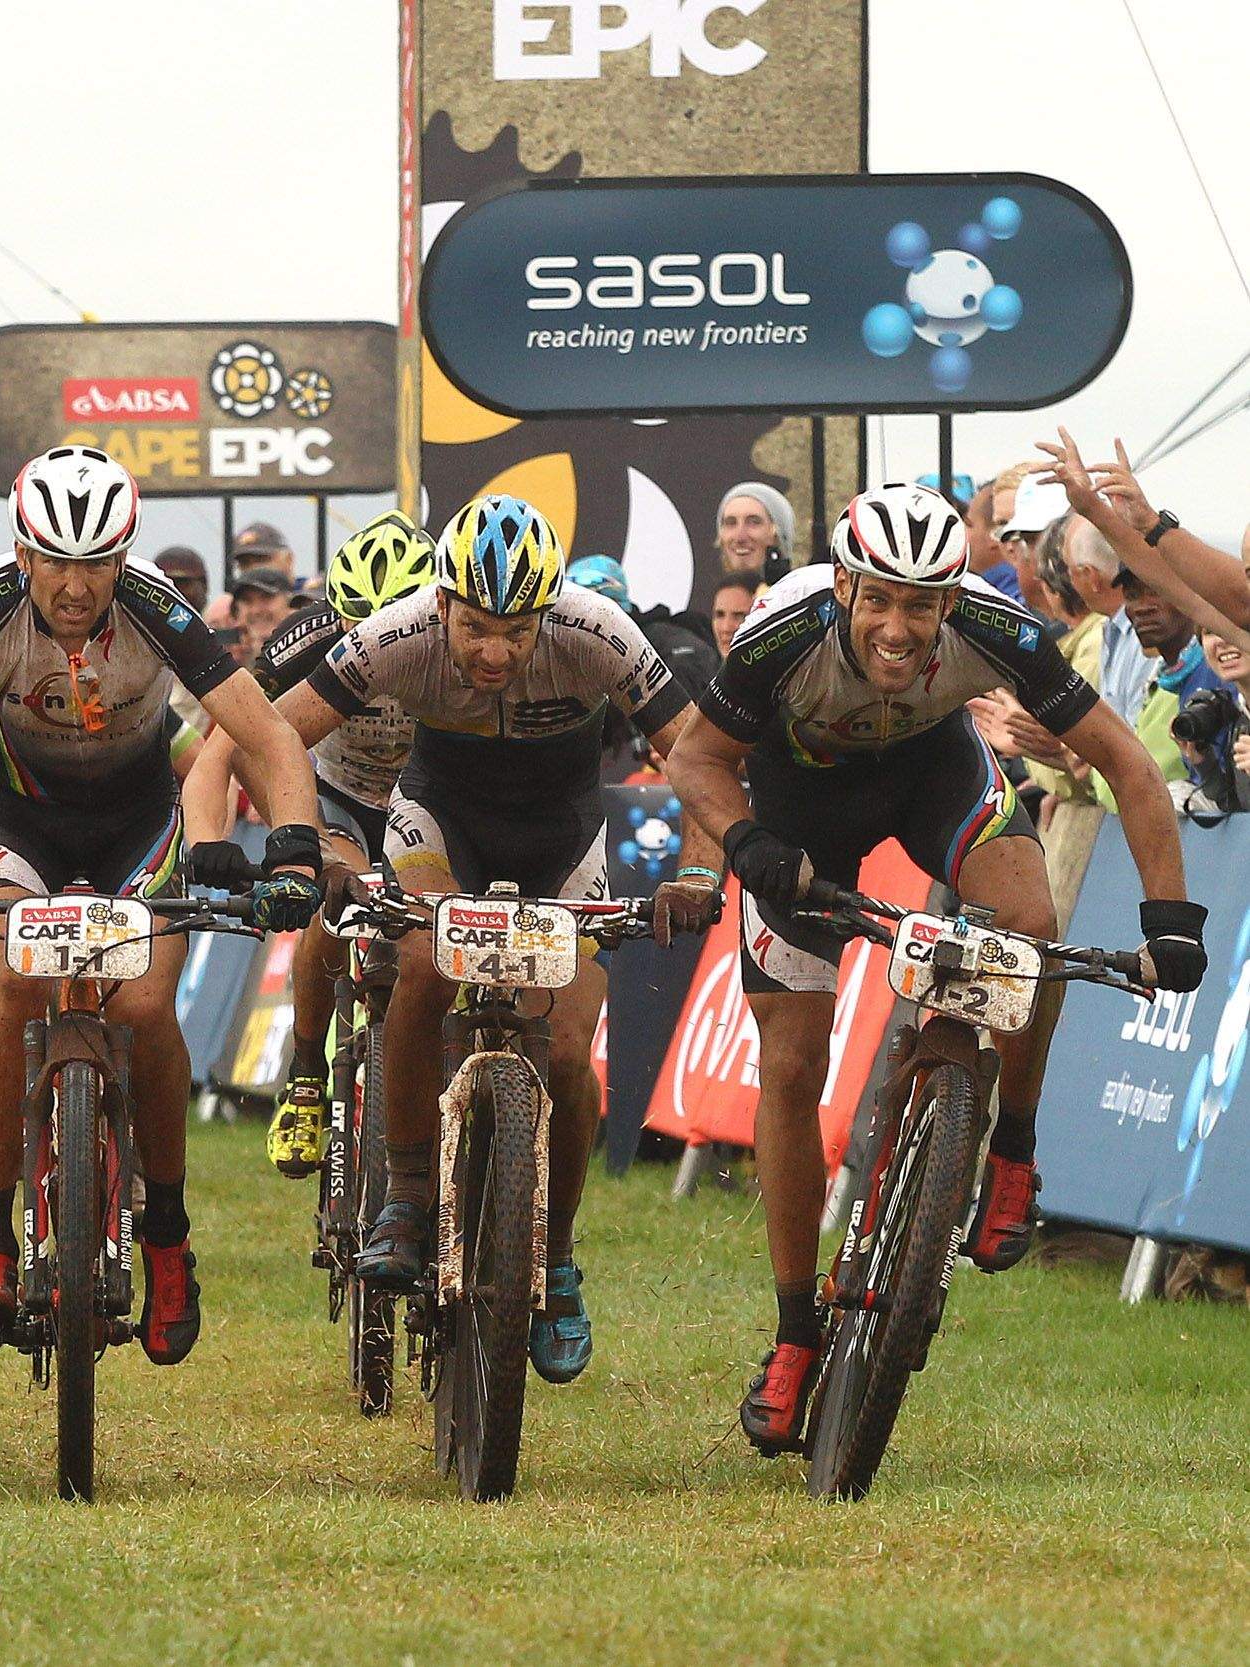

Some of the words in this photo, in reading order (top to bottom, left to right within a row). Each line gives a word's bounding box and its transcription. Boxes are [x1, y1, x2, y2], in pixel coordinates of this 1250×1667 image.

[494, 0, 767, 80] EPIC
[527, 321, 635, 353] reaching
[642, 326, 696, 348] new
[700, 320, 808, 351] frontiers
[118, 388, 190, 413] ABSA
[63, 430, 200, 477] APE
[209, 427, 334, 477] EPIC
[120, 573, 175, 614] locity
[517, 571, 539, 600] uvex
[547, 611, 630, 657] BULLS
[18, 923, 81, 941] CAPE
[446, 927, 508, 949] CAPE
[55, 944, 104, 973] 1-1
[477, 953, 537, 984] 4-1
[294, 1086, 320, 1100] SIDI
[331, 1100, 346, 1133] DT
[330, 1141, 345, 1198] SWISS
[23, 1207, 35, 1271] BRAIN
[120, 1207, 133, 1272] ROCKSHOX
[840, 1199, 866, 1263] BRAIN
[938, 1224, 964, 1291] ROCKSHOX
